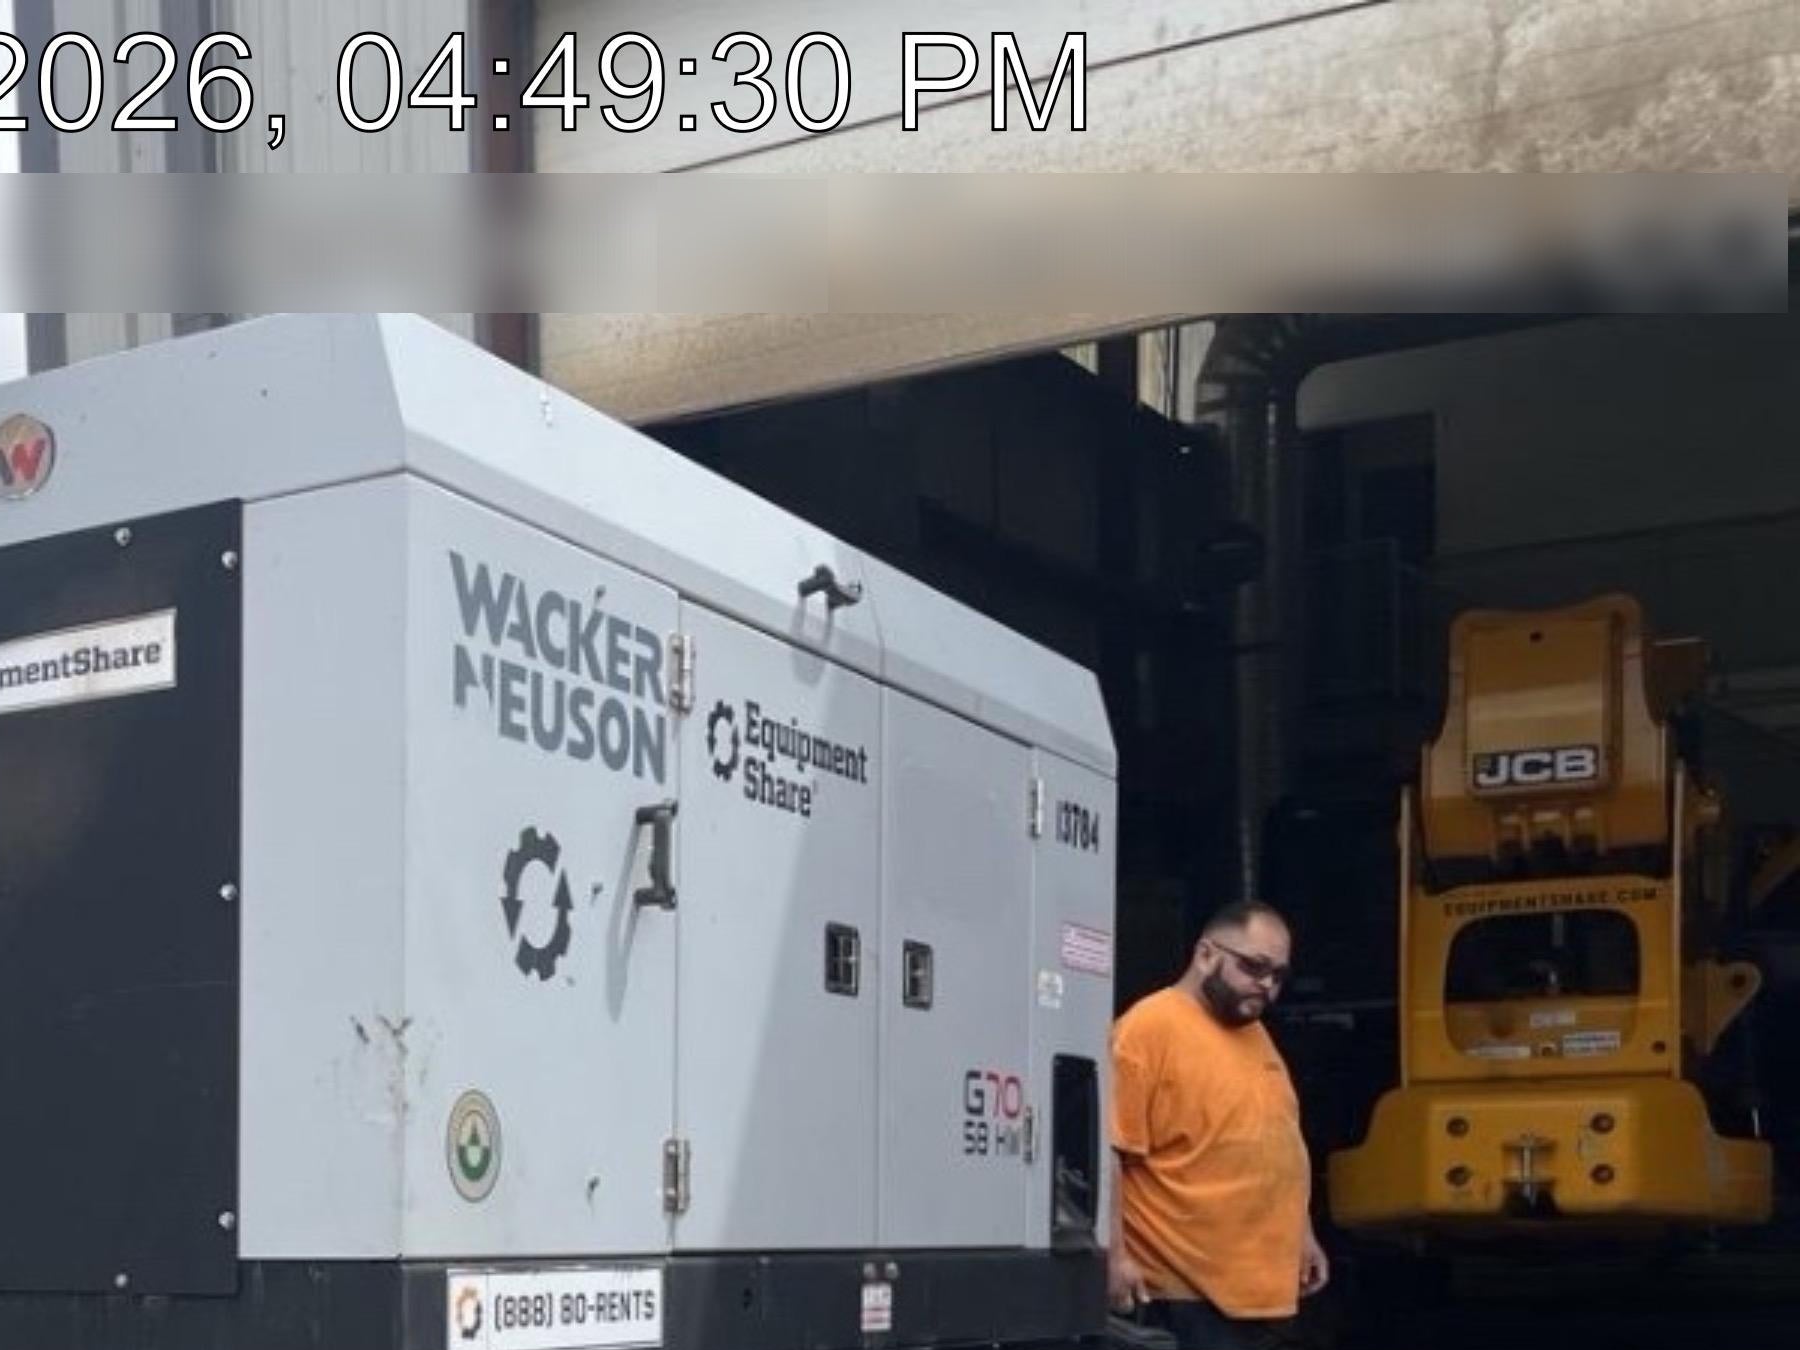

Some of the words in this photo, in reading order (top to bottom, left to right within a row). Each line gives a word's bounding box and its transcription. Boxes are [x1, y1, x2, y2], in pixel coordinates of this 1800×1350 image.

[450, 549, 667, 707] WACKER
[453, 642, 666, 786] NEUSON
[744, 698, 869, 785] Equipment
[742, 755, 813, 819] Share
[1476, 748, 1597, 786] JCB
[963, 1069, 1024, 1120] G70
[494, 1292, 554, 1332] (888)
[559, 1289, 656, 1326] 80-RENTS
